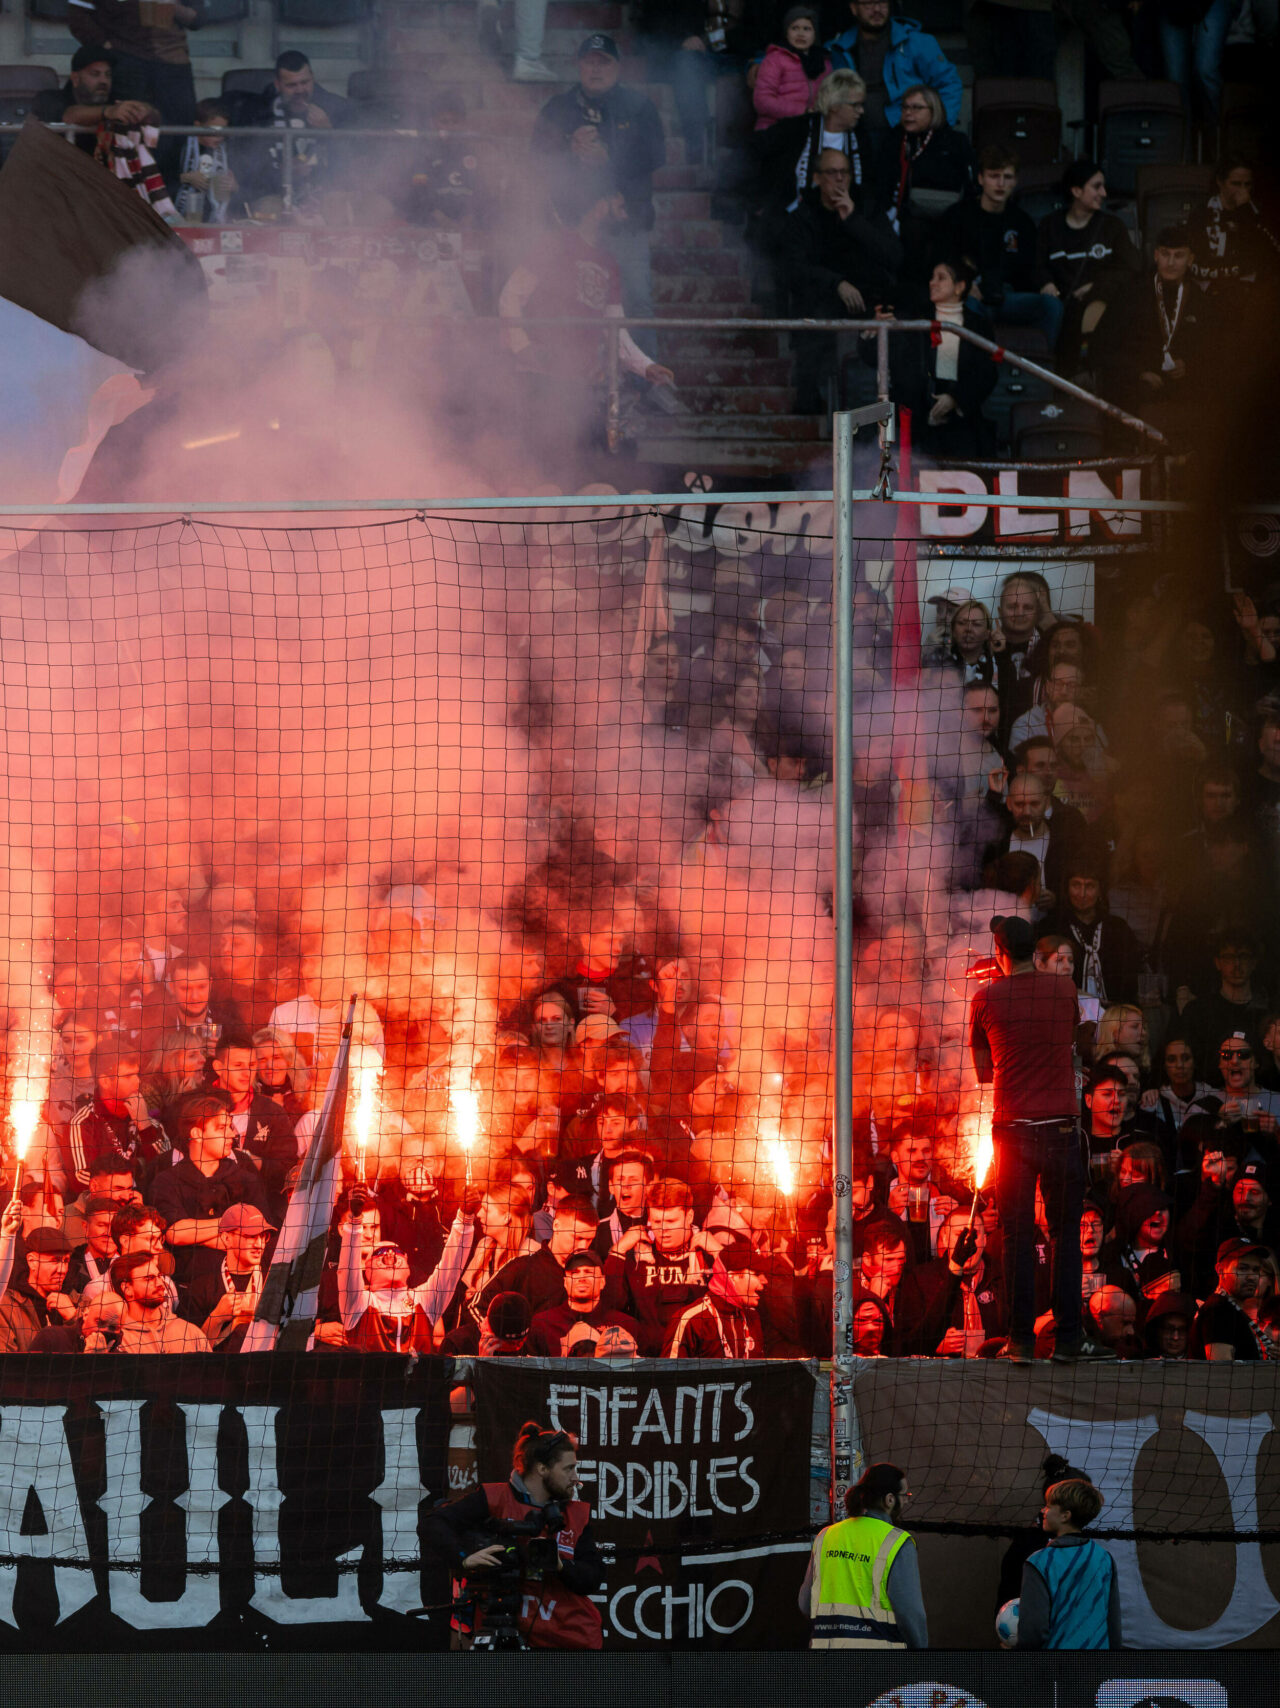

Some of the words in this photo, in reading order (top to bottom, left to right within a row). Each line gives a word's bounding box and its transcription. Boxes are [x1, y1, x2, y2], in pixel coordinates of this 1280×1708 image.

[547, 1382, 755, 1447] ENFANTS
[572, 1456, 760, 1520] ERRIBLES
[522, 1595, 557, 1621] TV
[588, 1580, 754, 1640] CCHIO
